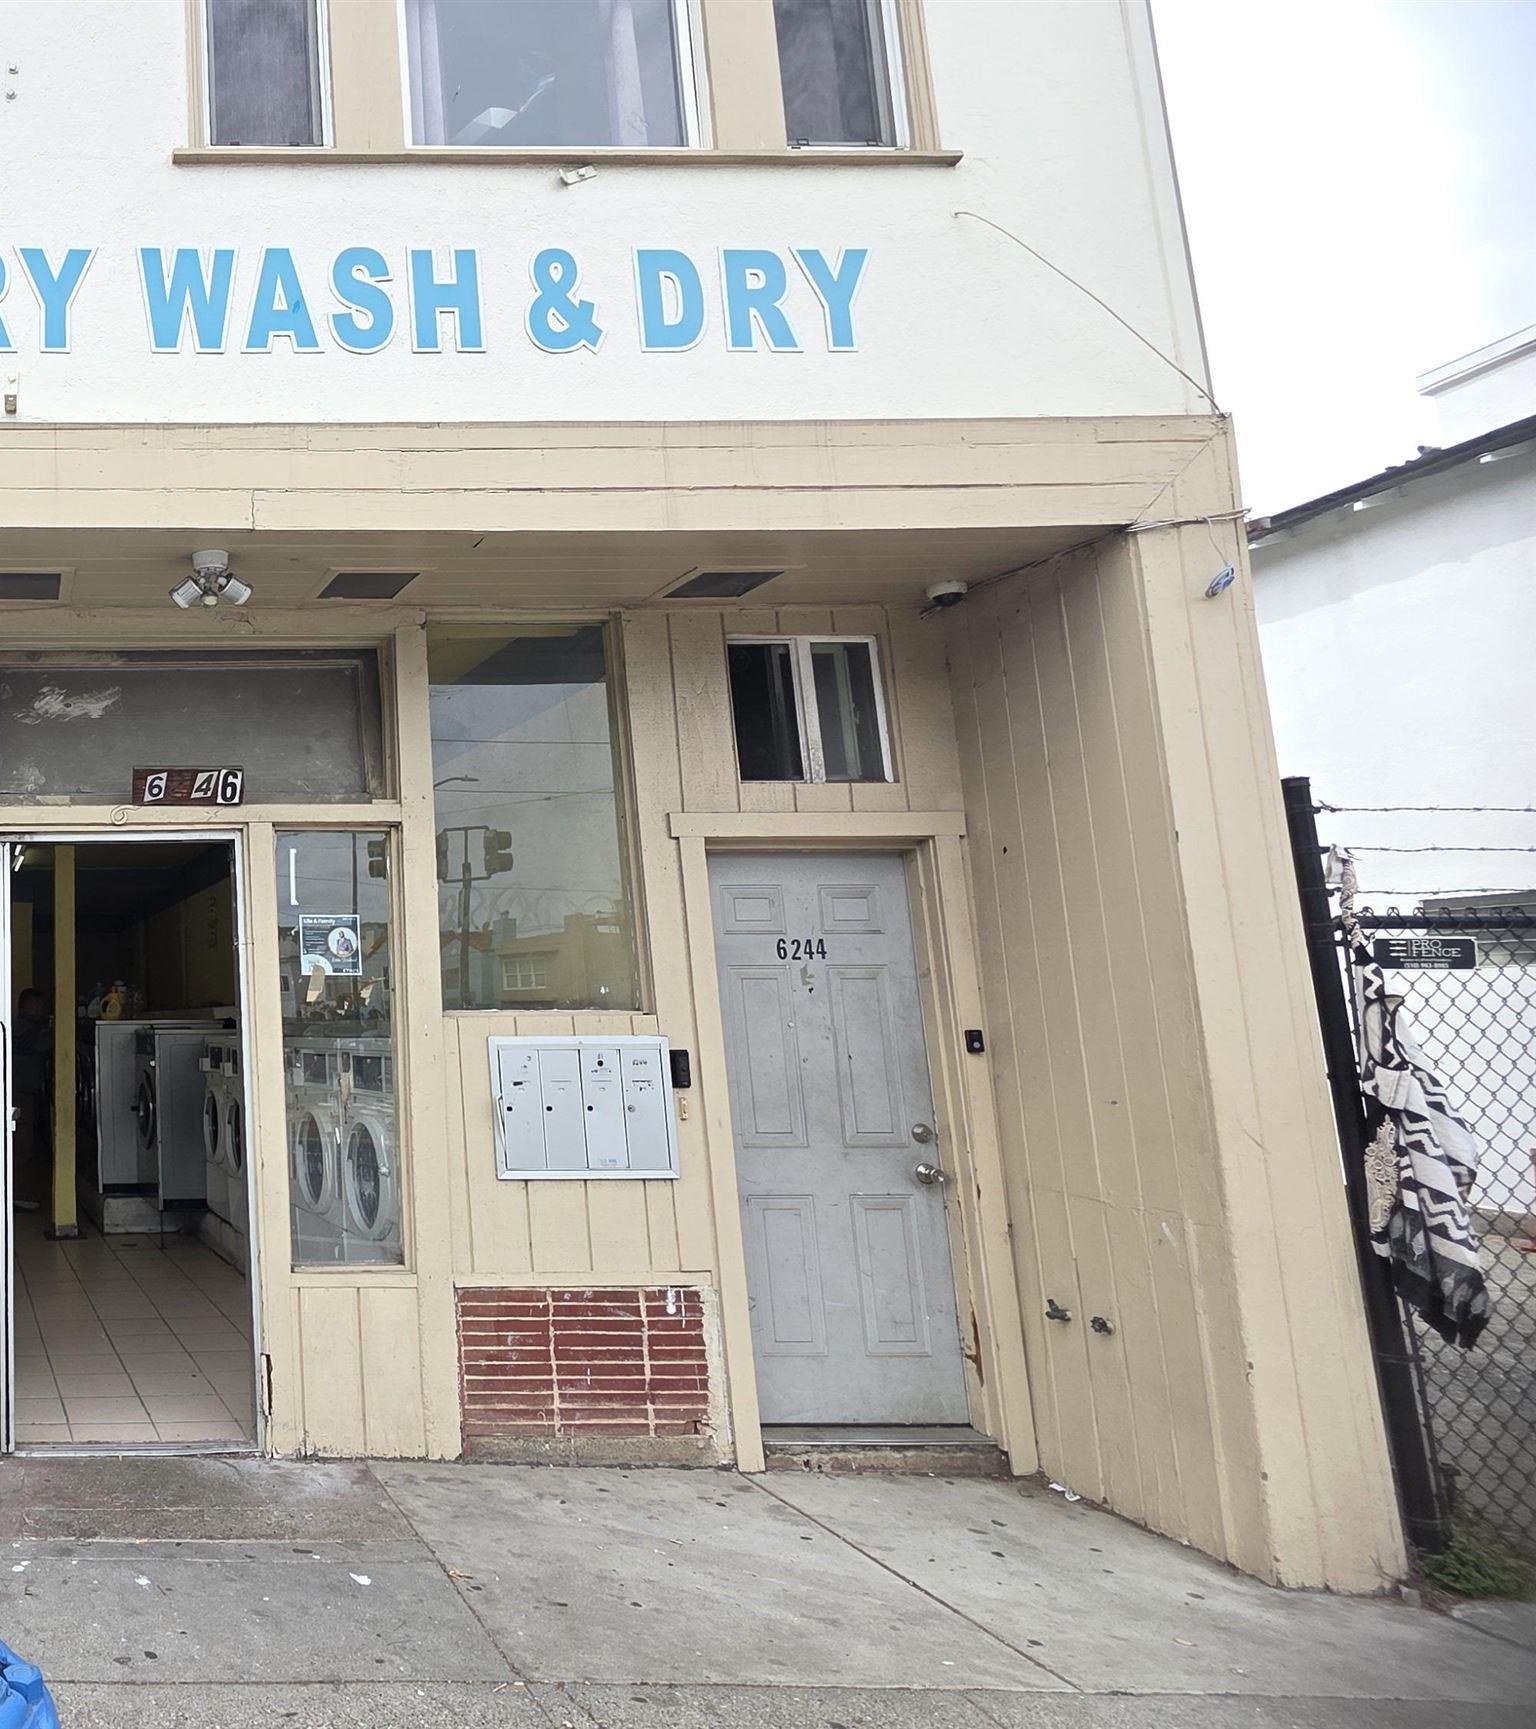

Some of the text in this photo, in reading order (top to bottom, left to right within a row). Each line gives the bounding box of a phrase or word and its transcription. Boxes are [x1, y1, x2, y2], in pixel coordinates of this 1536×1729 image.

[139, 247, 485, 351] WASH
[527, 248, 603, 352] &
[634, 247, 869, 350] DRY
[776, 938, 827, 960] 6244
[1412, 939, 1442, 949] PRO
[1412, 948, 1461, 957] FENCE
